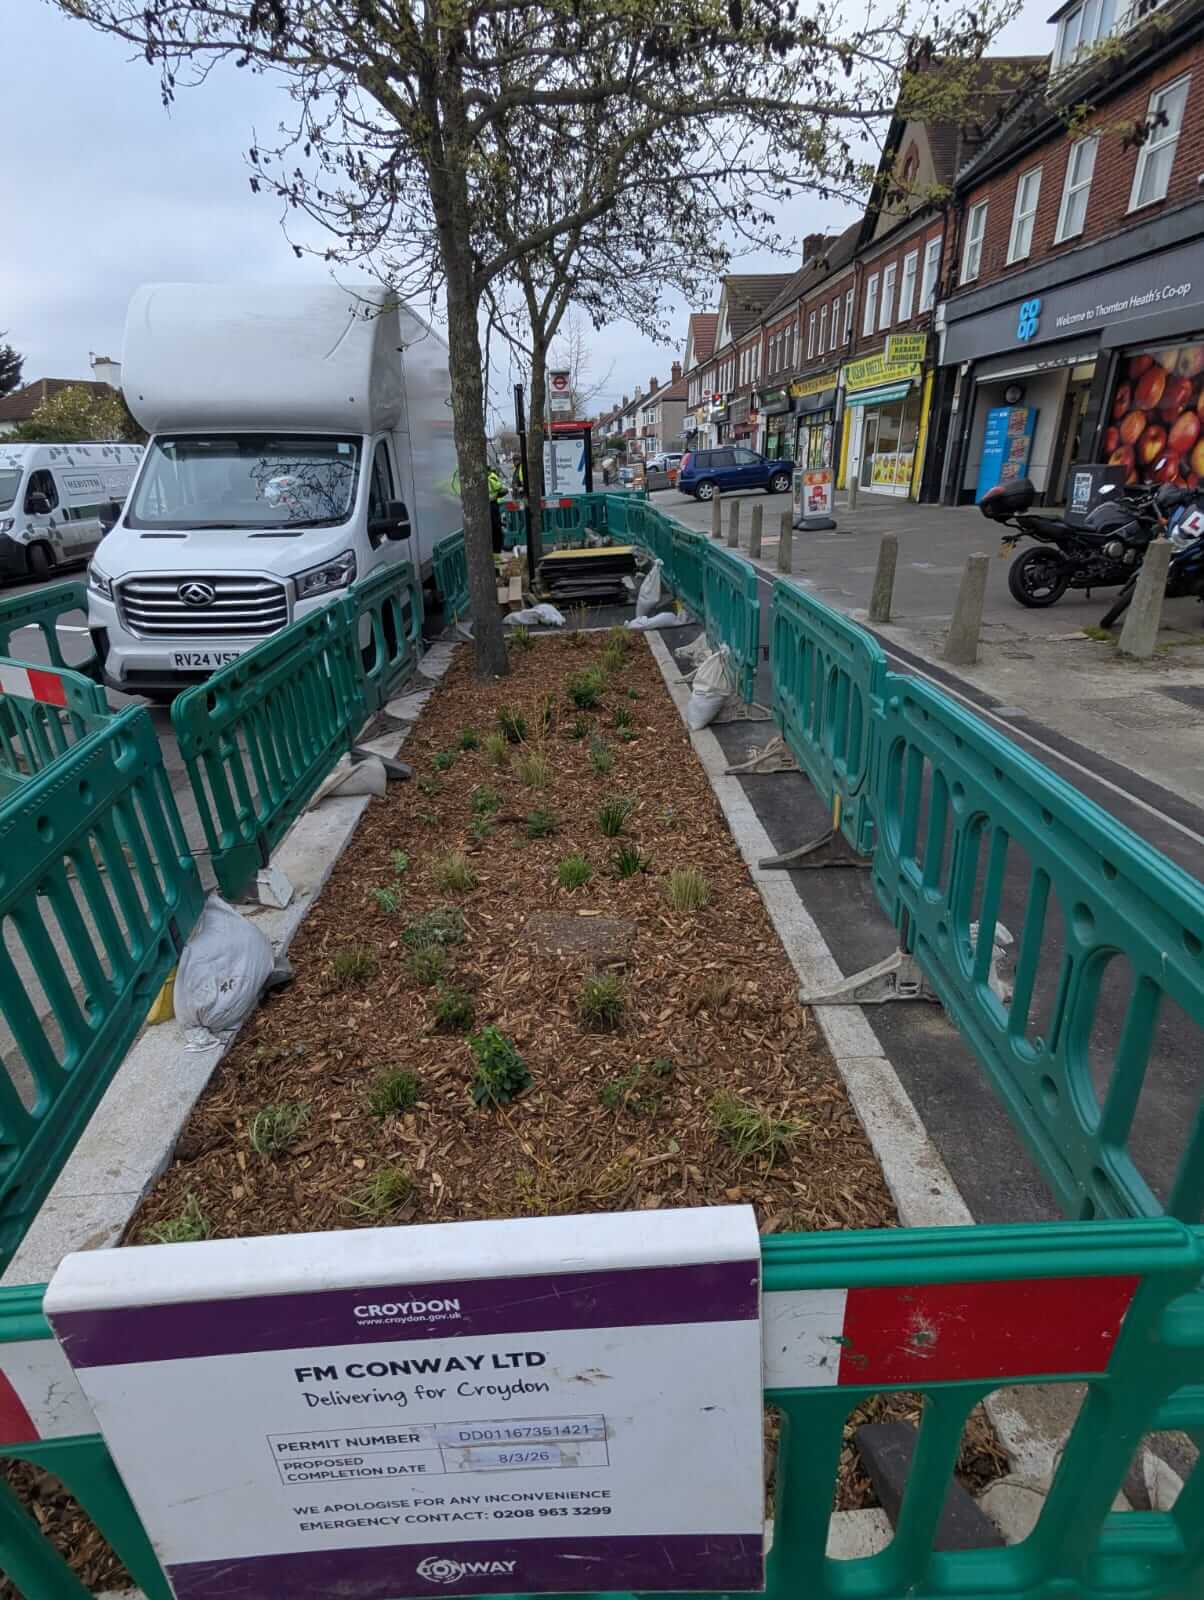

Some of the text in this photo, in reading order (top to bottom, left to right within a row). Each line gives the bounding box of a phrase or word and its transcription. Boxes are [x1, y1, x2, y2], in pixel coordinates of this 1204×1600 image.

[1056, 282, 1192, 327] Welcome to Thornton Heath's Co-op
[174, 653, 211, 666] RV24
[353, 1299, 461, 1318] CROYDON
[357, 1311, 462, 1327] www.croydon.gov.uk
[294, 1351, 546, 1382] FM CONWAY LTD
[303, 1379, 550, 1407] Delivering for Croydon
[277, 1433, 421, 1452] PERMIT NUMBER
[459, 1424, 590, 1442] DD01167351421
[283, 1457, 364, 1471] PROPOSED
[498, 1451, 550, 1464] 8/3/26
[287, 1464, 427, 1482] COMPLETION DATE
[293, 1490, 611, 1515] WE APOLOGISE FOR ANY INCONVENIENCE
[299, 1506, 612, 1531] EMERGENCY CONTACT: 0208 963 3299
